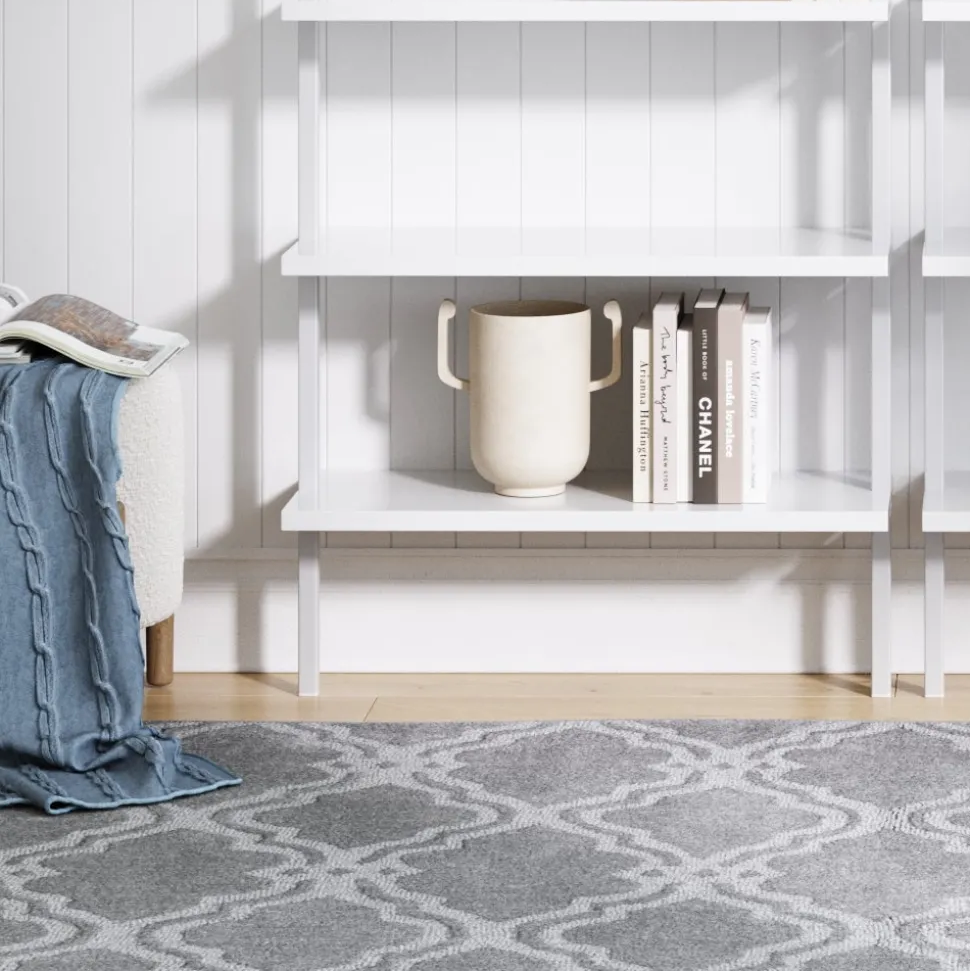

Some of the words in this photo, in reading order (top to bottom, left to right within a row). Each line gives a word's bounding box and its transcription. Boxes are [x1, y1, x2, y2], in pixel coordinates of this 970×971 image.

[639, 360, 649, 405] Arianna
[702, 371, 708, 381] OF
[637, 410, 649, 472] Huffington
[698, 397, 713, 478] CHANEL
